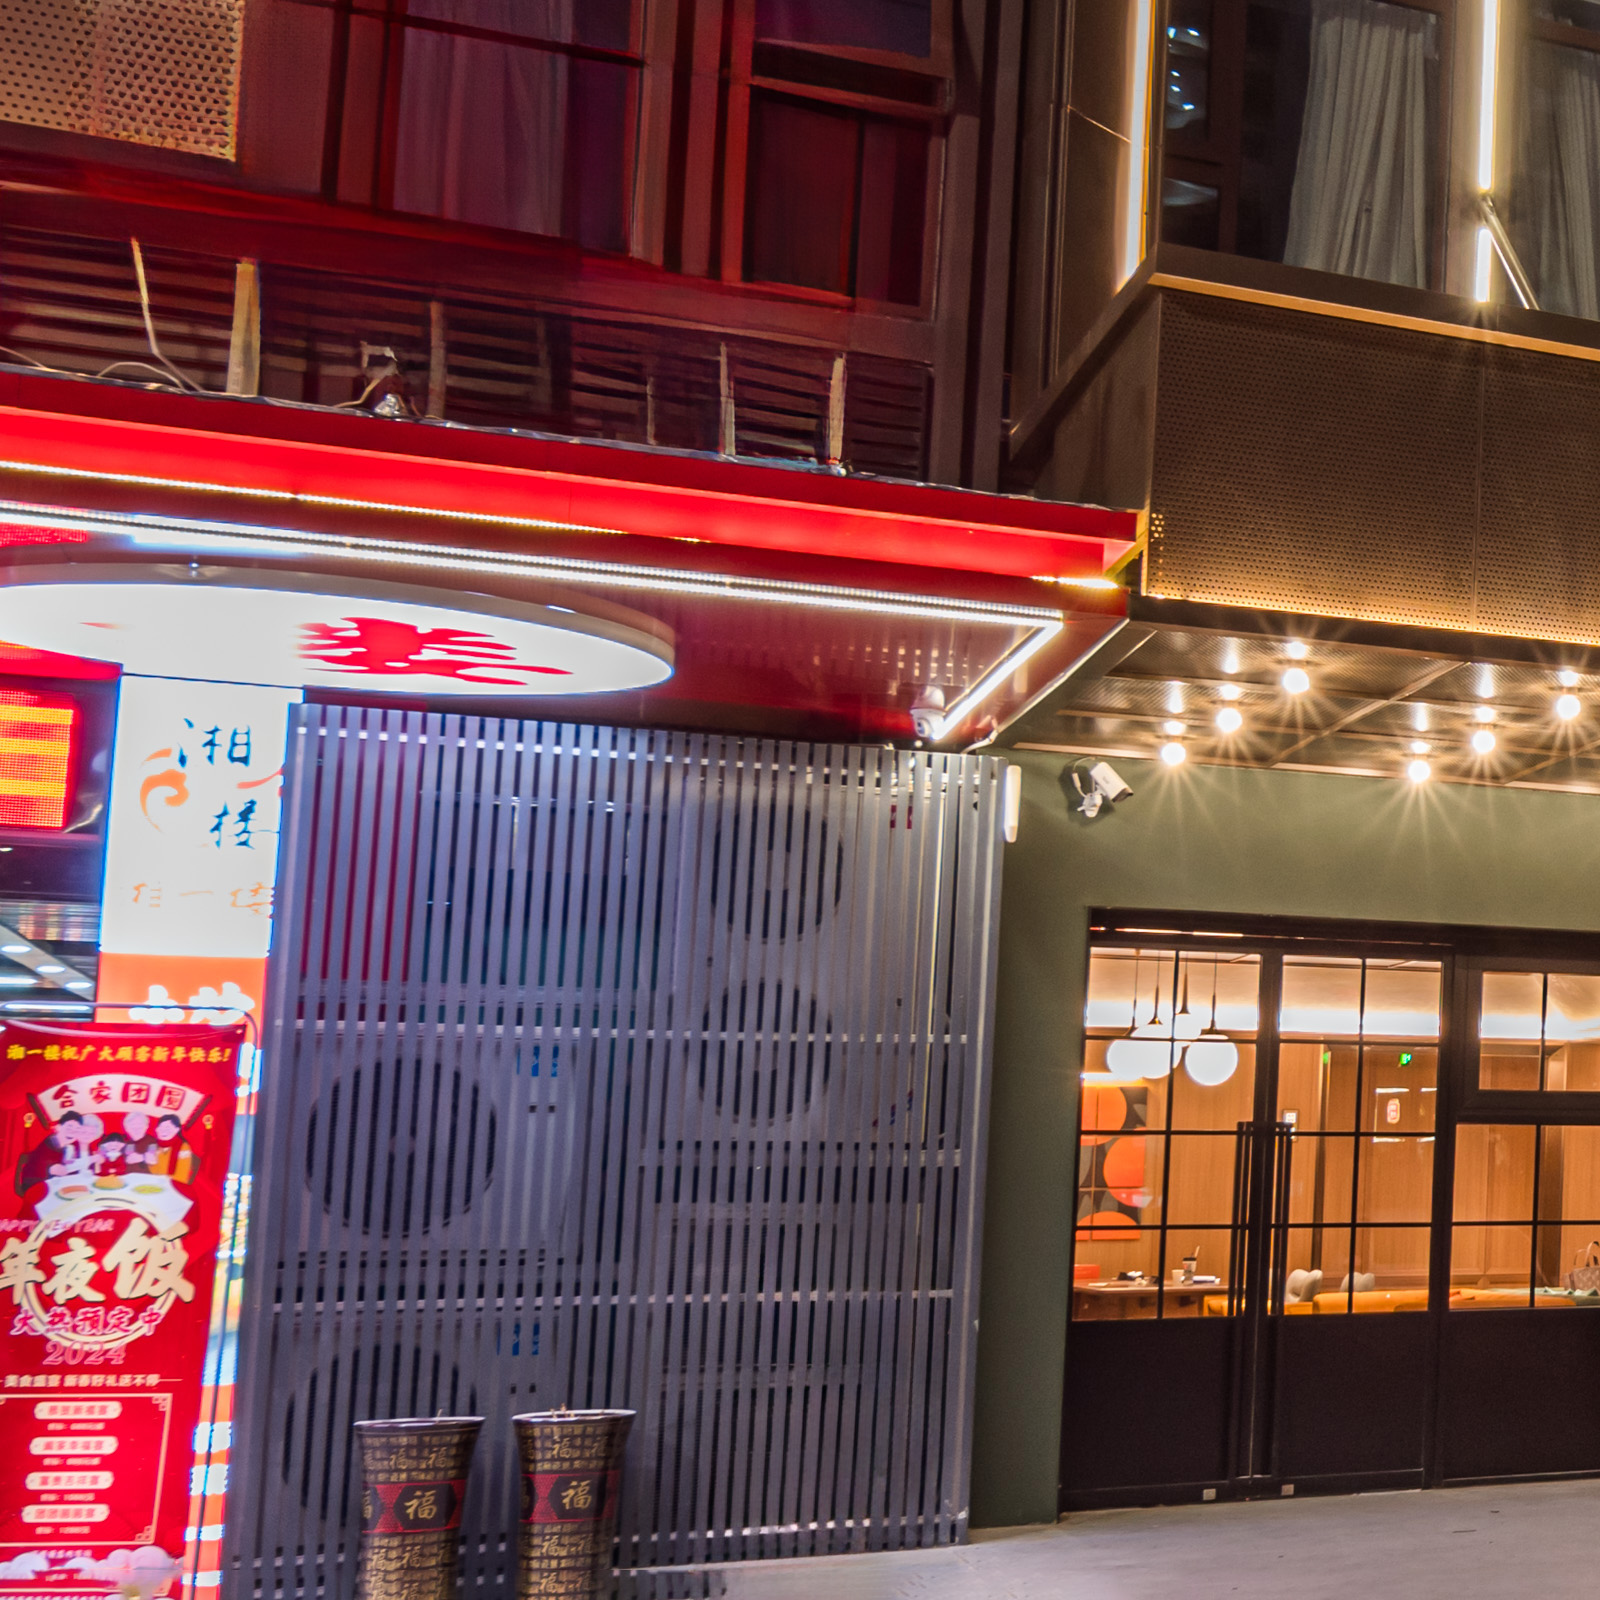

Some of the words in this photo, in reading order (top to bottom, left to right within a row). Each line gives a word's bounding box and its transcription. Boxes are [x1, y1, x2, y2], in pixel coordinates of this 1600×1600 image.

[42, 1341, 127, 1366] 2024
[404, 1490, 437, 1520] 福
[561, 1480, 592, 1510] 福
